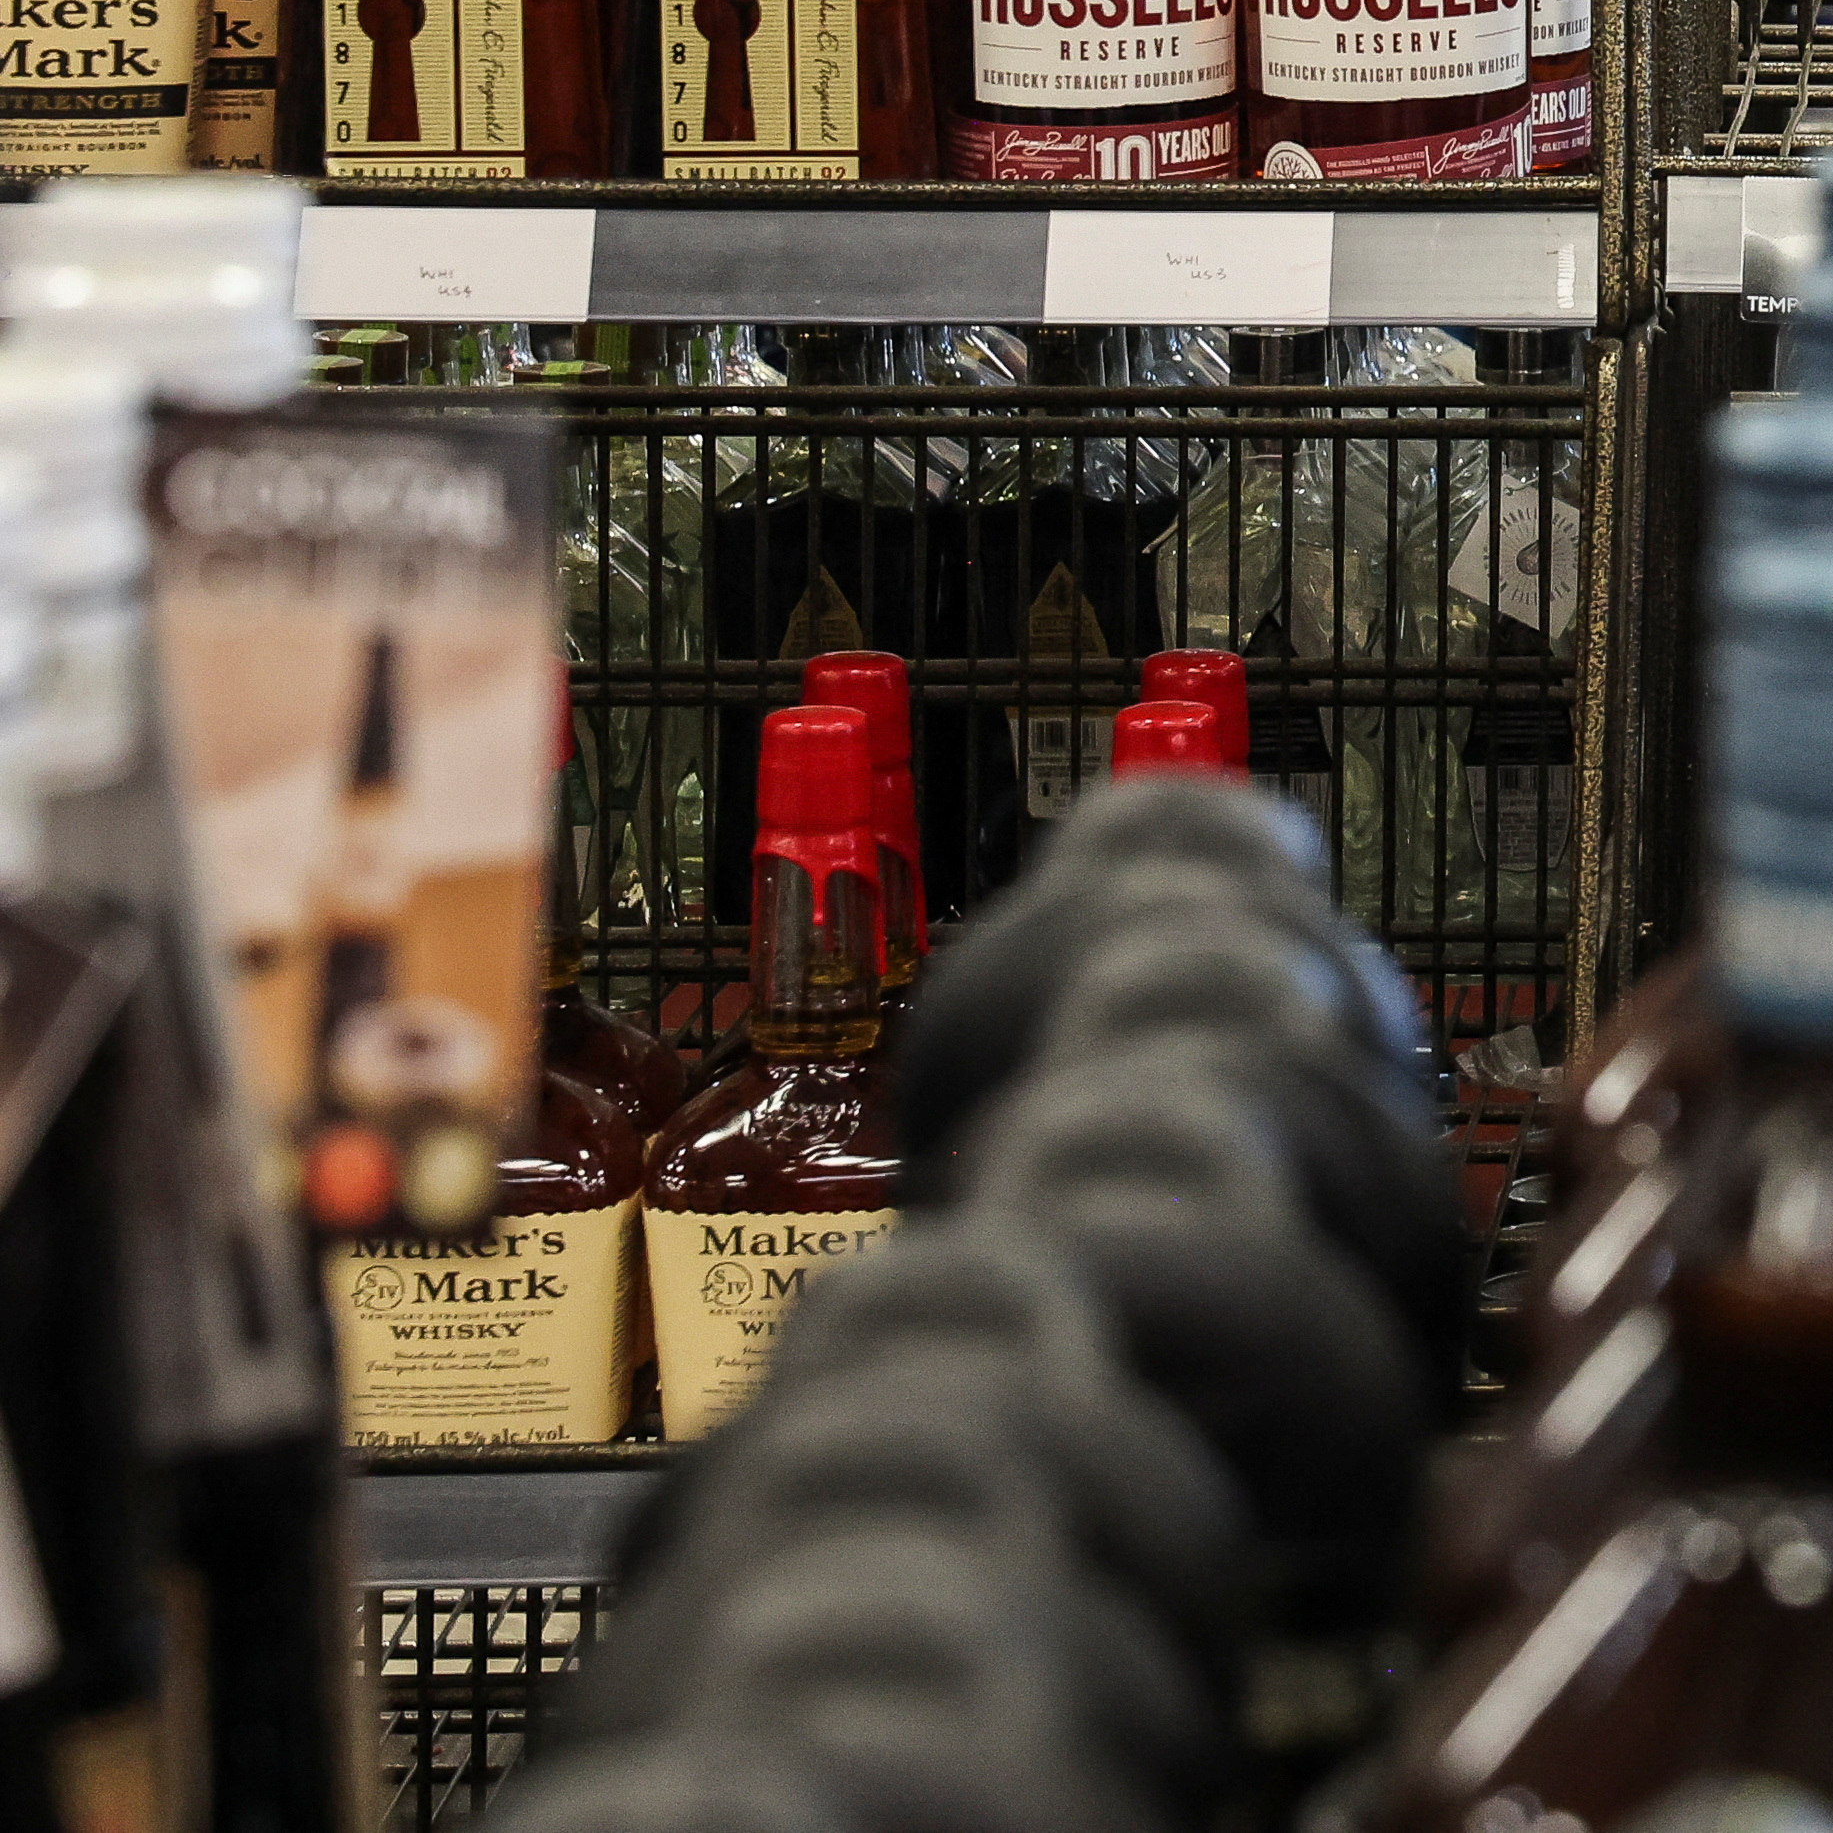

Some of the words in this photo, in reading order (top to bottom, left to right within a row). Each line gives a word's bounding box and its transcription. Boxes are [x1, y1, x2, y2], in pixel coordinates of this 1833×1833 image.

[1060, 36, 1180, 62] RESERVE
[1336, 29, 1458, 53] RESERVE
[983, 68, 1048, 90] KENTUCKY
[1054, 73, 1127, 90] STRAIGHT
[1134, 69, 1194, 88] BOURBON
[1268, 61, 1327, 82] KENTUCKY
[1332, 67, 1402, 83] STRAIGHT
[1410, 62, 1473, 82] BOURBON
[1478, 53, 1520, 75] WHISKEY
[1532, 92, 1567, 126] EARS
[1568, 86, 1587, 119] OLD
[1095, 135, 1151, 180] 10
[1158, 126, 1211, 166] YEARS
[1746, 295, 1800, 314] TEMP
[699, 1224, 893, 1258] Maker'
[412, 1269, 566, 1304] Mark
[391, 1322, 526, 1341] WHISKY
